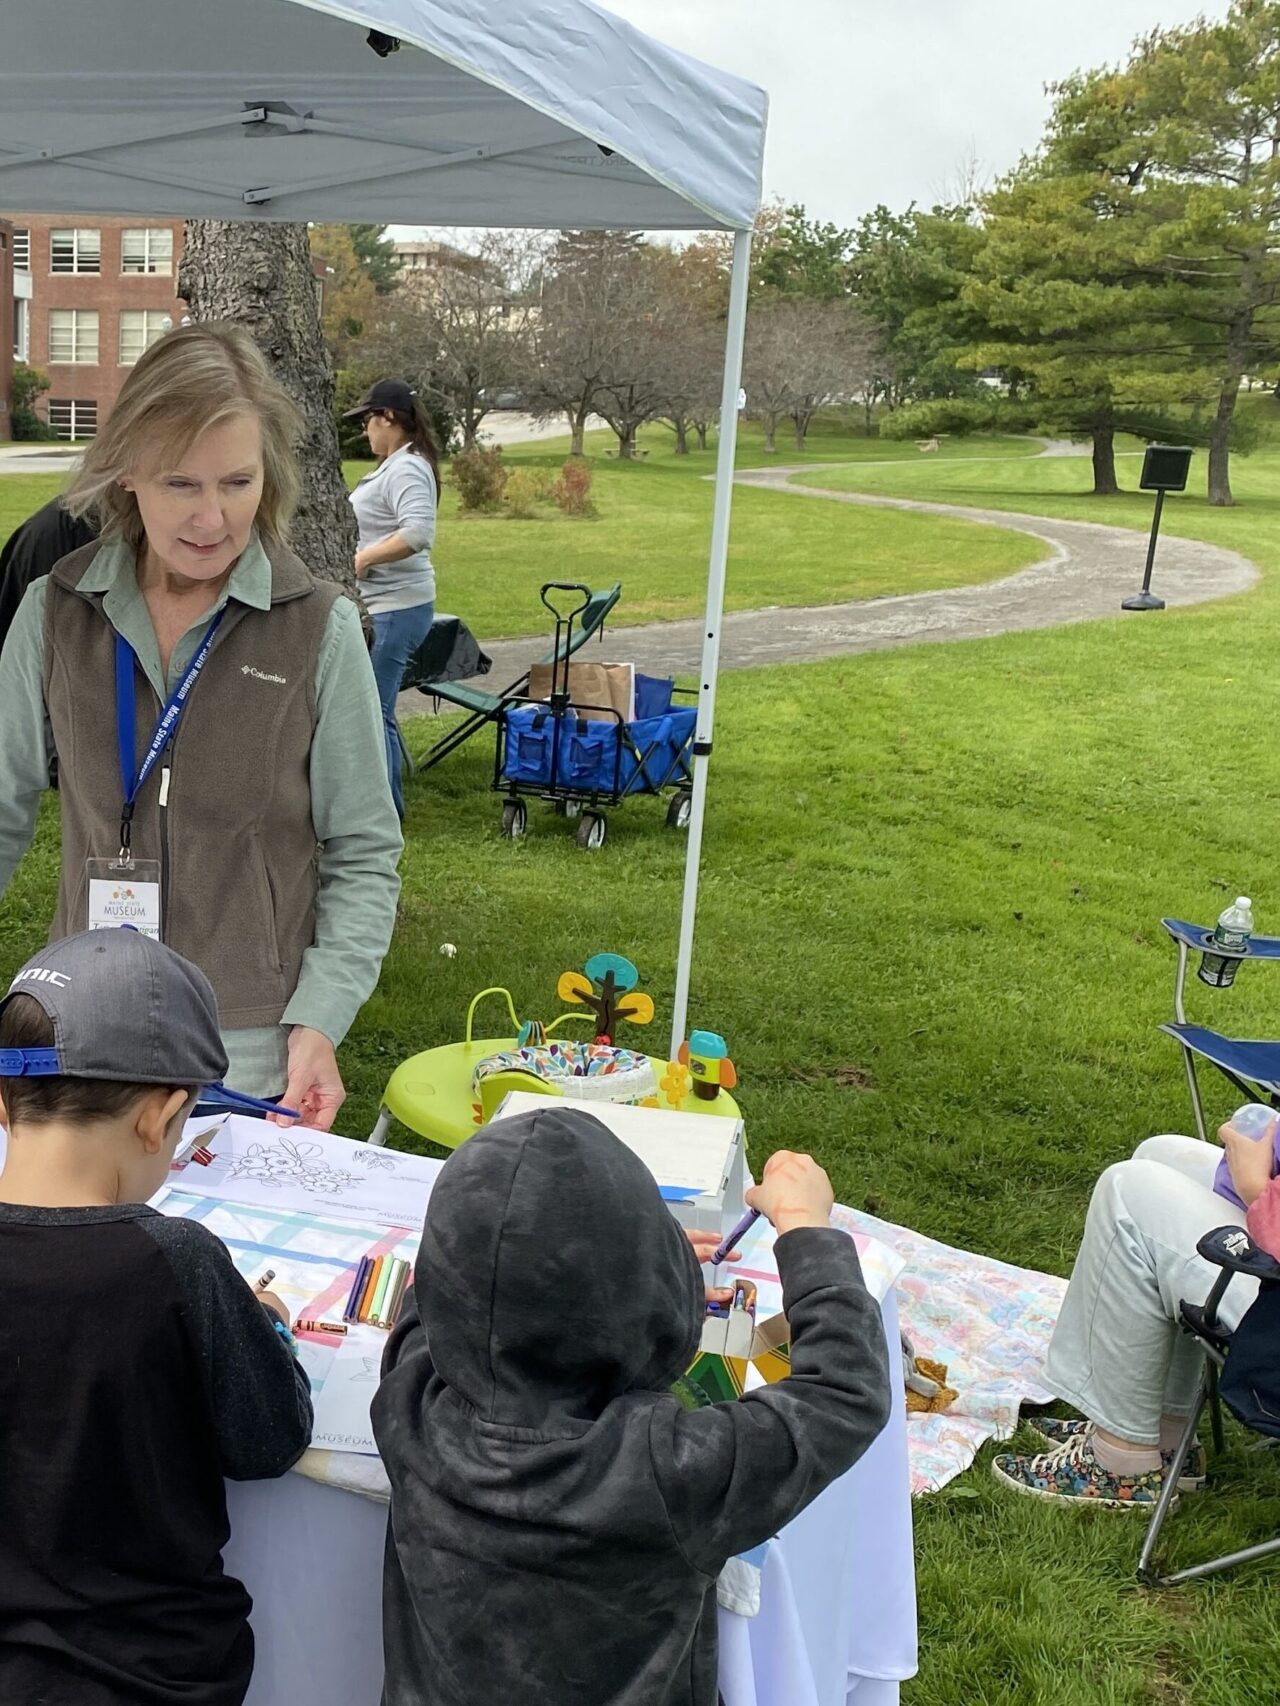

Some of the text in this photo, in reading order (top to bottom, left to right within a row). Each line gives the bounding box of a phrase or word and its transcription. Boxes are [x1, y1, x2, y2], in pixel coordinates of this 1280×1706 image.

[177, 670, 199, 700] Museum
[250, 667, 286, 684] Columbia
[139, 705, 180, 780] Maine State Museum
[104, 905, 146, 917] MUSEUM
